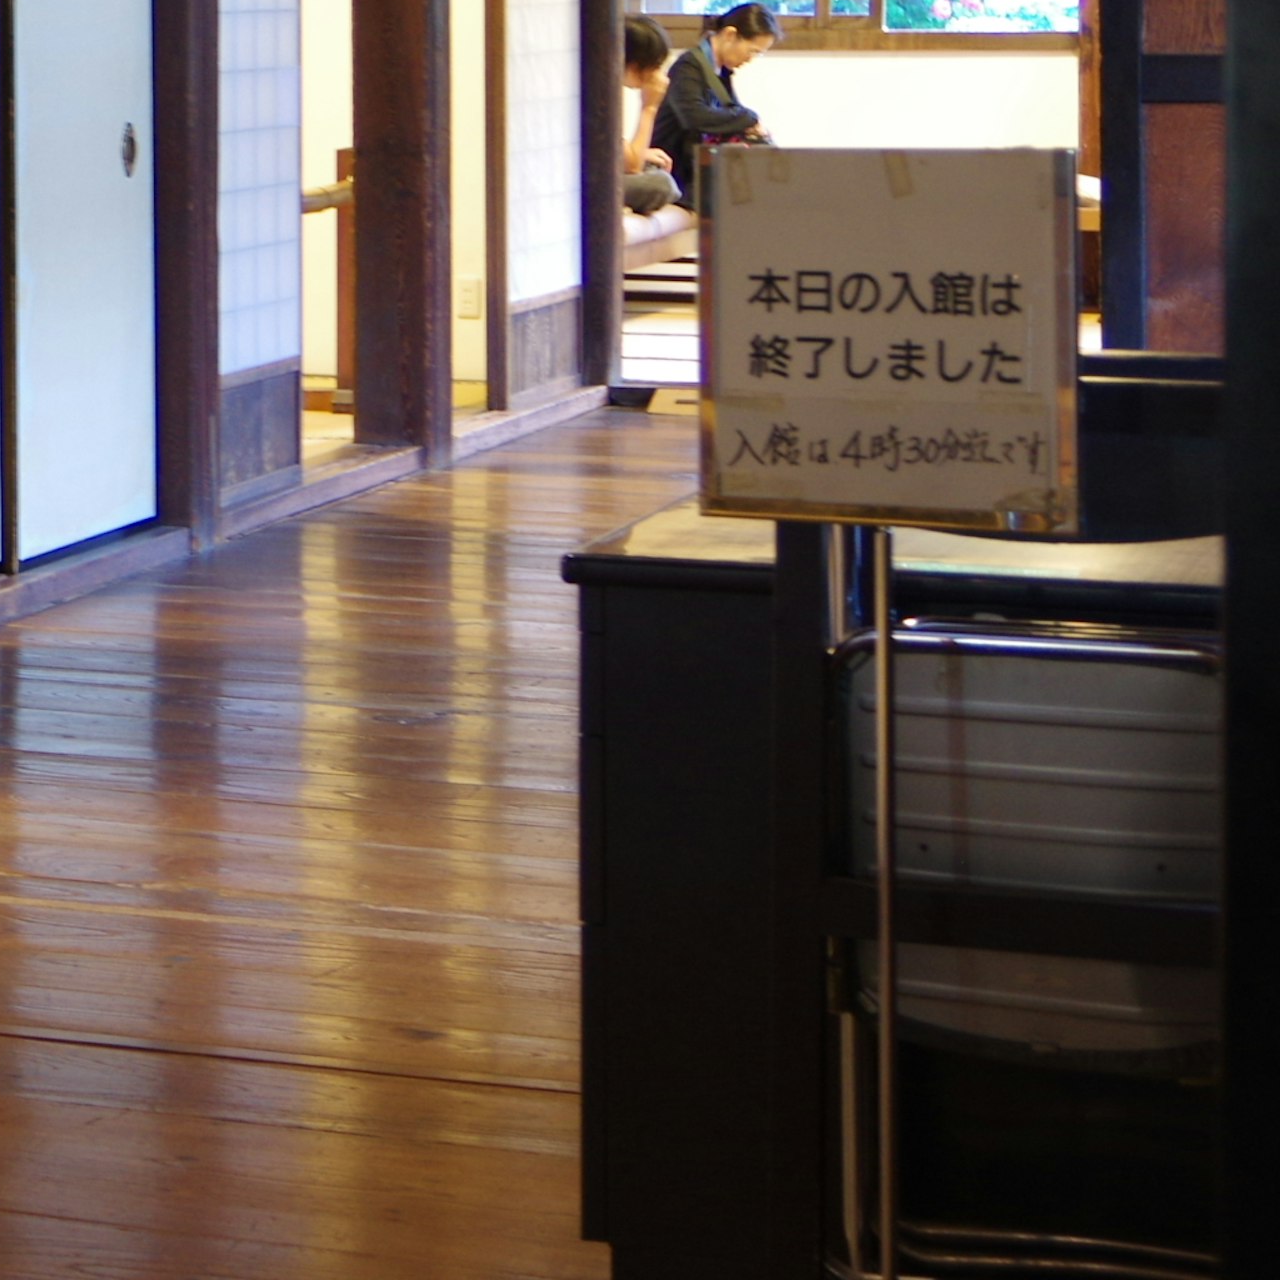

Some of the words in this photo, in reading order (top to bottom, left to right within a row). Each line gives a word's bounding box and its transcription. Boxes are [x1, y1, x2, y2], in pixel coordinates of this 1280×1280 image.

[746, 267, 1023, 317] 本日の入館は
[747, 333, 1023, 385] 終了しました
